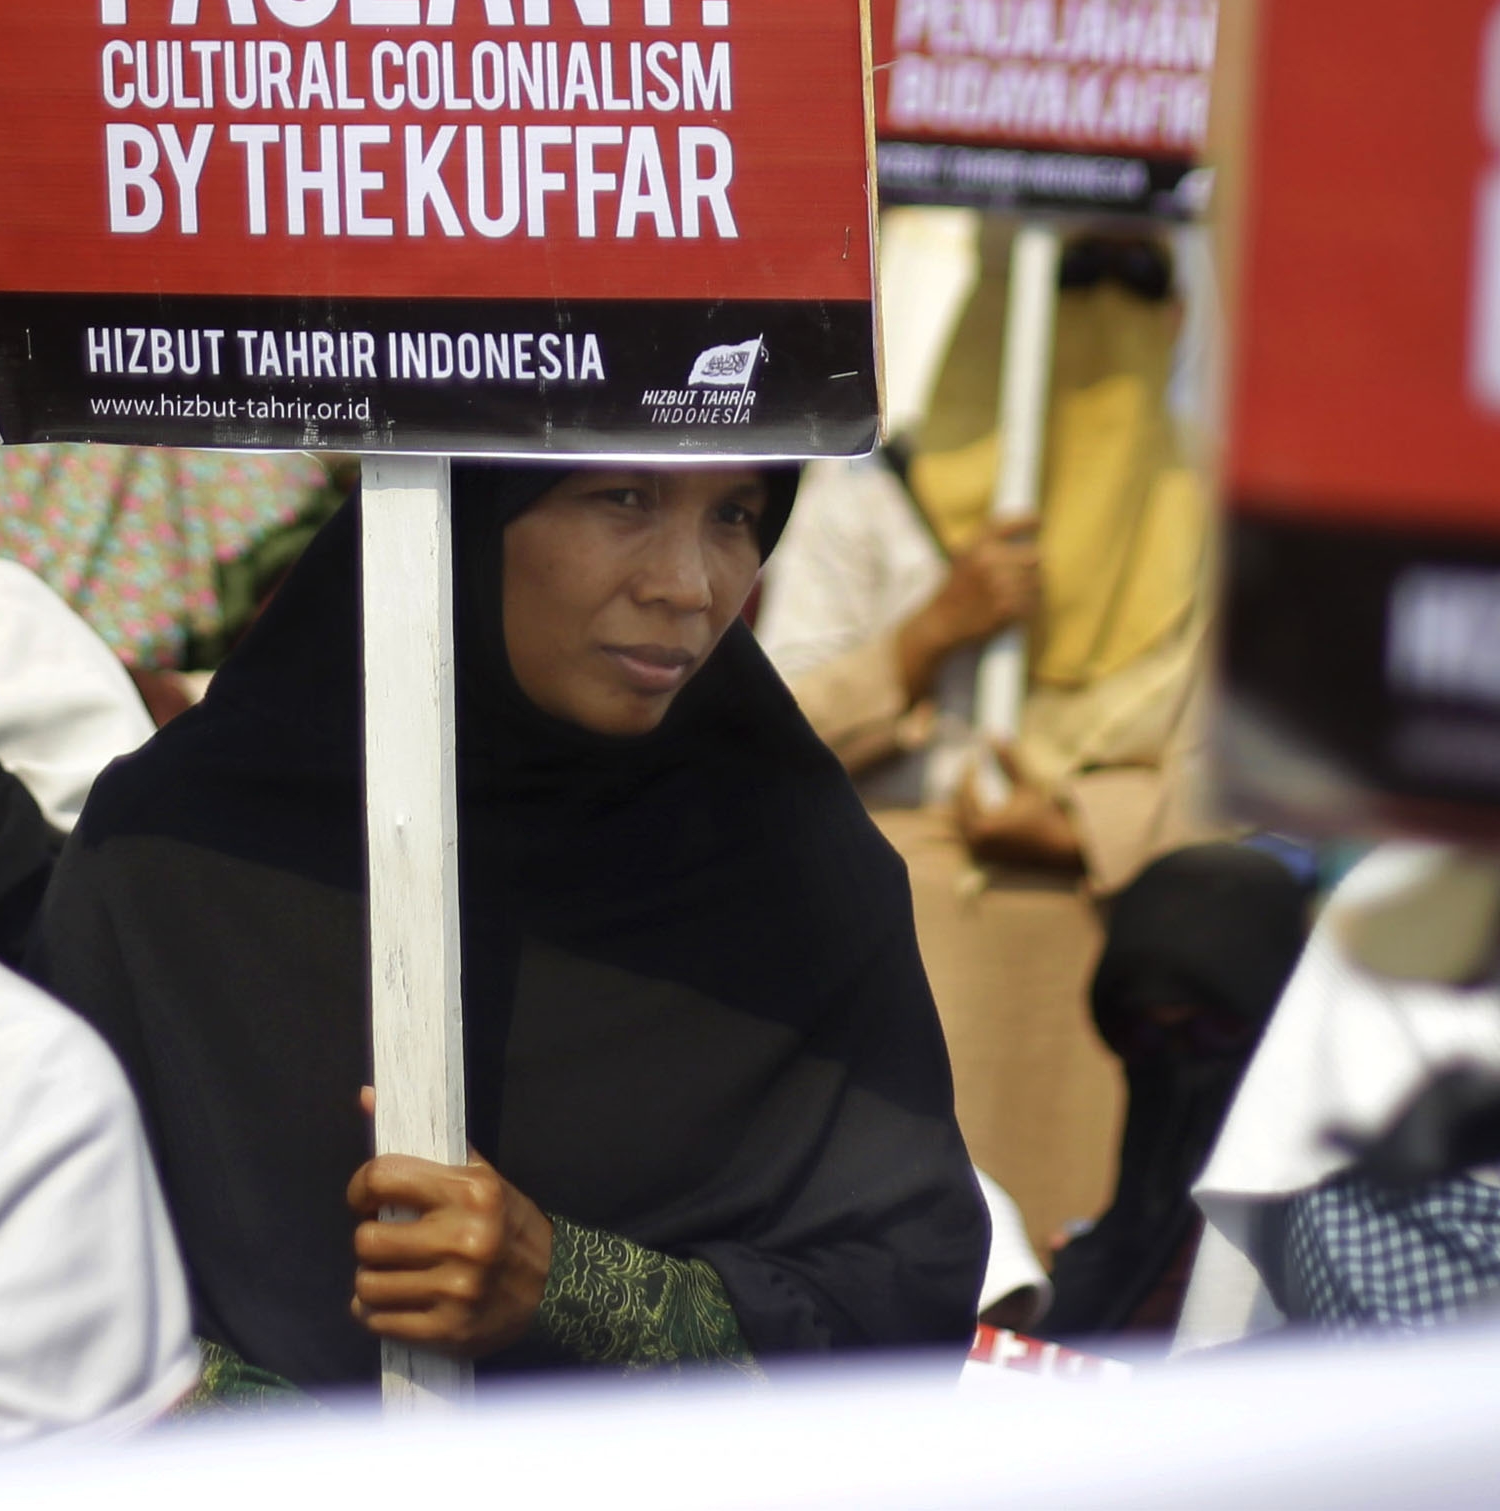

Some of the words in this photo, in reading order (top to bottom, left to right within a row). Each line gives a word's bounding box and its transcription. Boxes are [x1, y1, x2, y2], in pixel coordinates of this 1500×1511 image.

[102, 39, 365, 110] CULTURAL
[371, 41, 732, 112] COLONIALISM
[105, 122, 214, 235] BY
[230, 124, 393, 238] THE
[408, 125, 739, 239] KUFFAR
[86, 326, 225, 375] HIZBUT
[237, 330, 378, 378] TAHRIR
[388, 332, 606, 381] INDONESIA
[90, 394, 371, 420] www.hizbut-tahrir.or.id
[641, 390, 698, 406] HIZBUT
